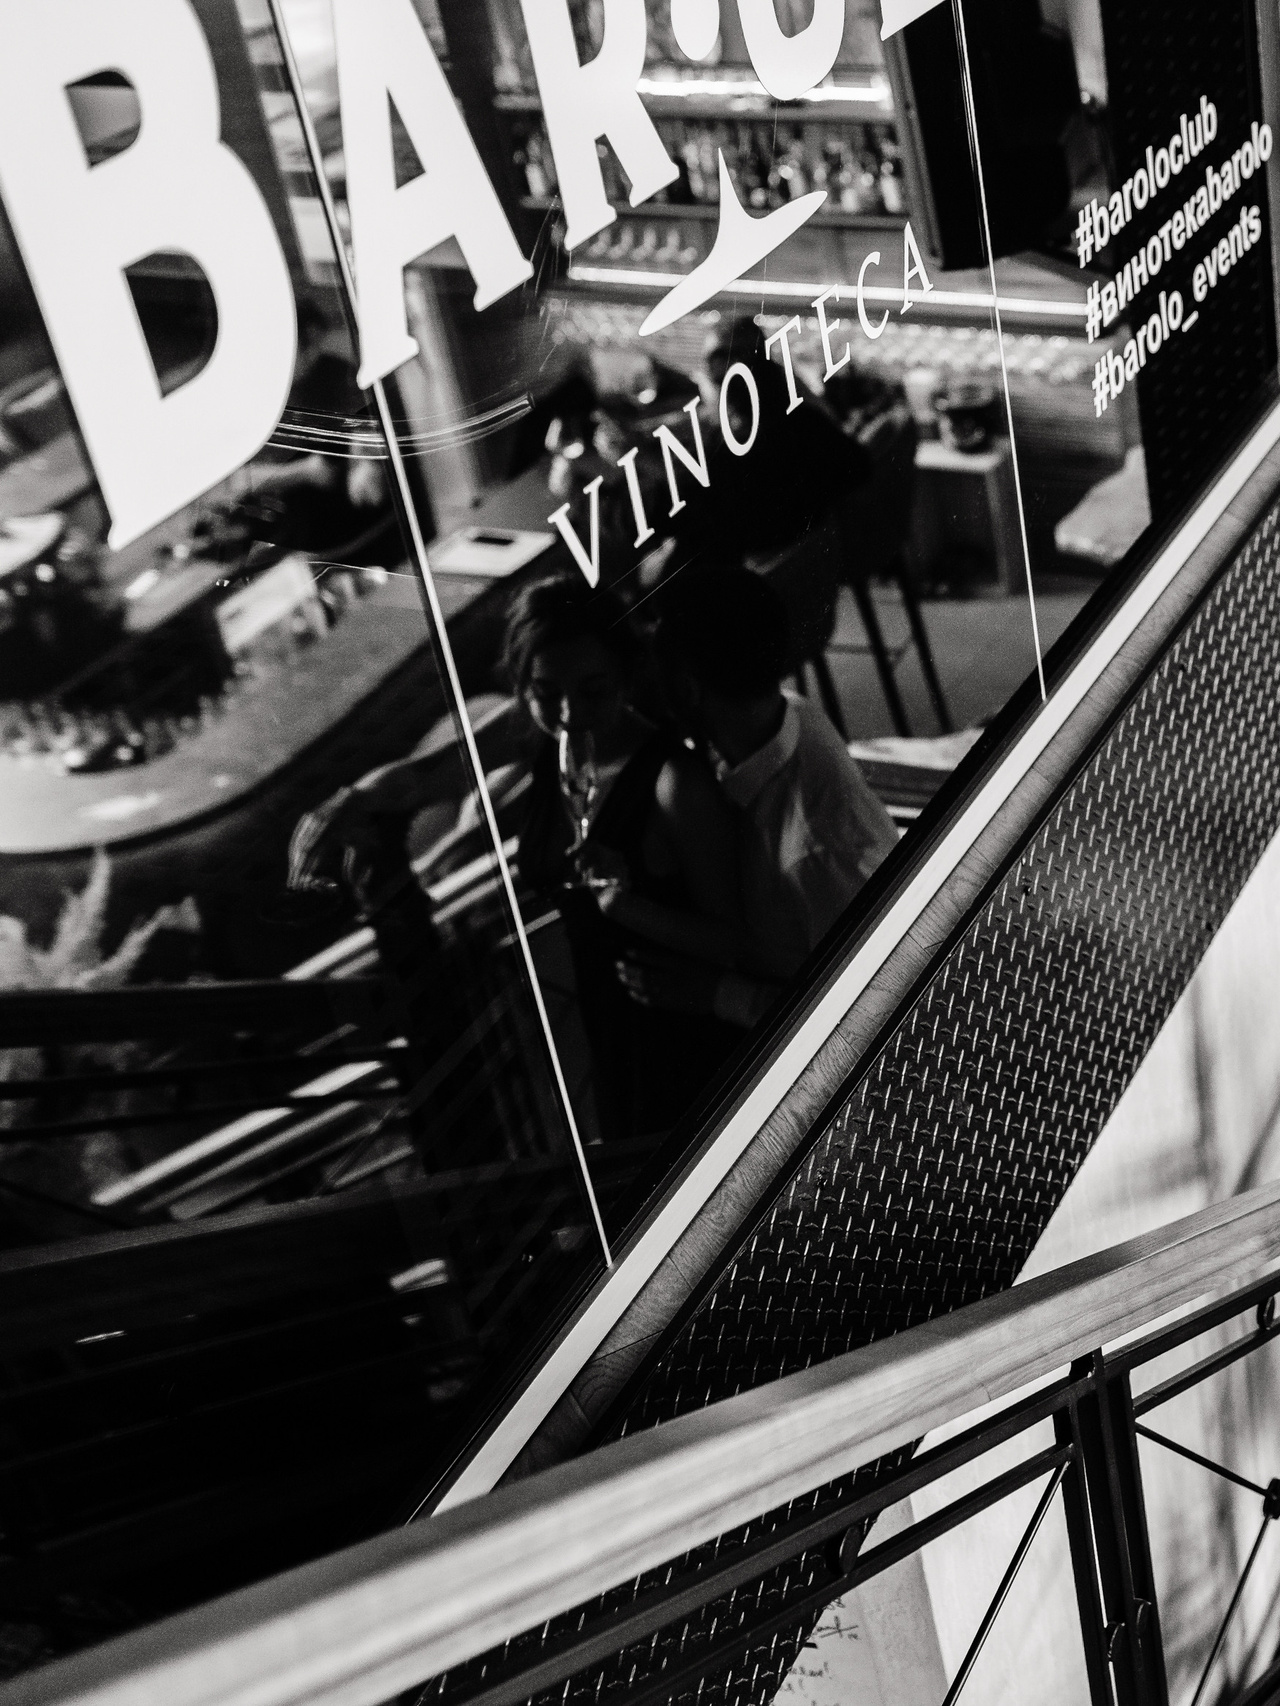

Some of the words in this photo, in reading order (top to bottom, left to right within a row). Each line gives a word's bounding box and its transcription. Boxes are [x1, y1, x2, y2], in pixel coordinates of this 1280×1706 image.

[1075, 95, 1218, 269] #baroloclub
[547, 221, 934, 589] VINOTECA
[1092, 205, 1262, 418] #barolo_events
